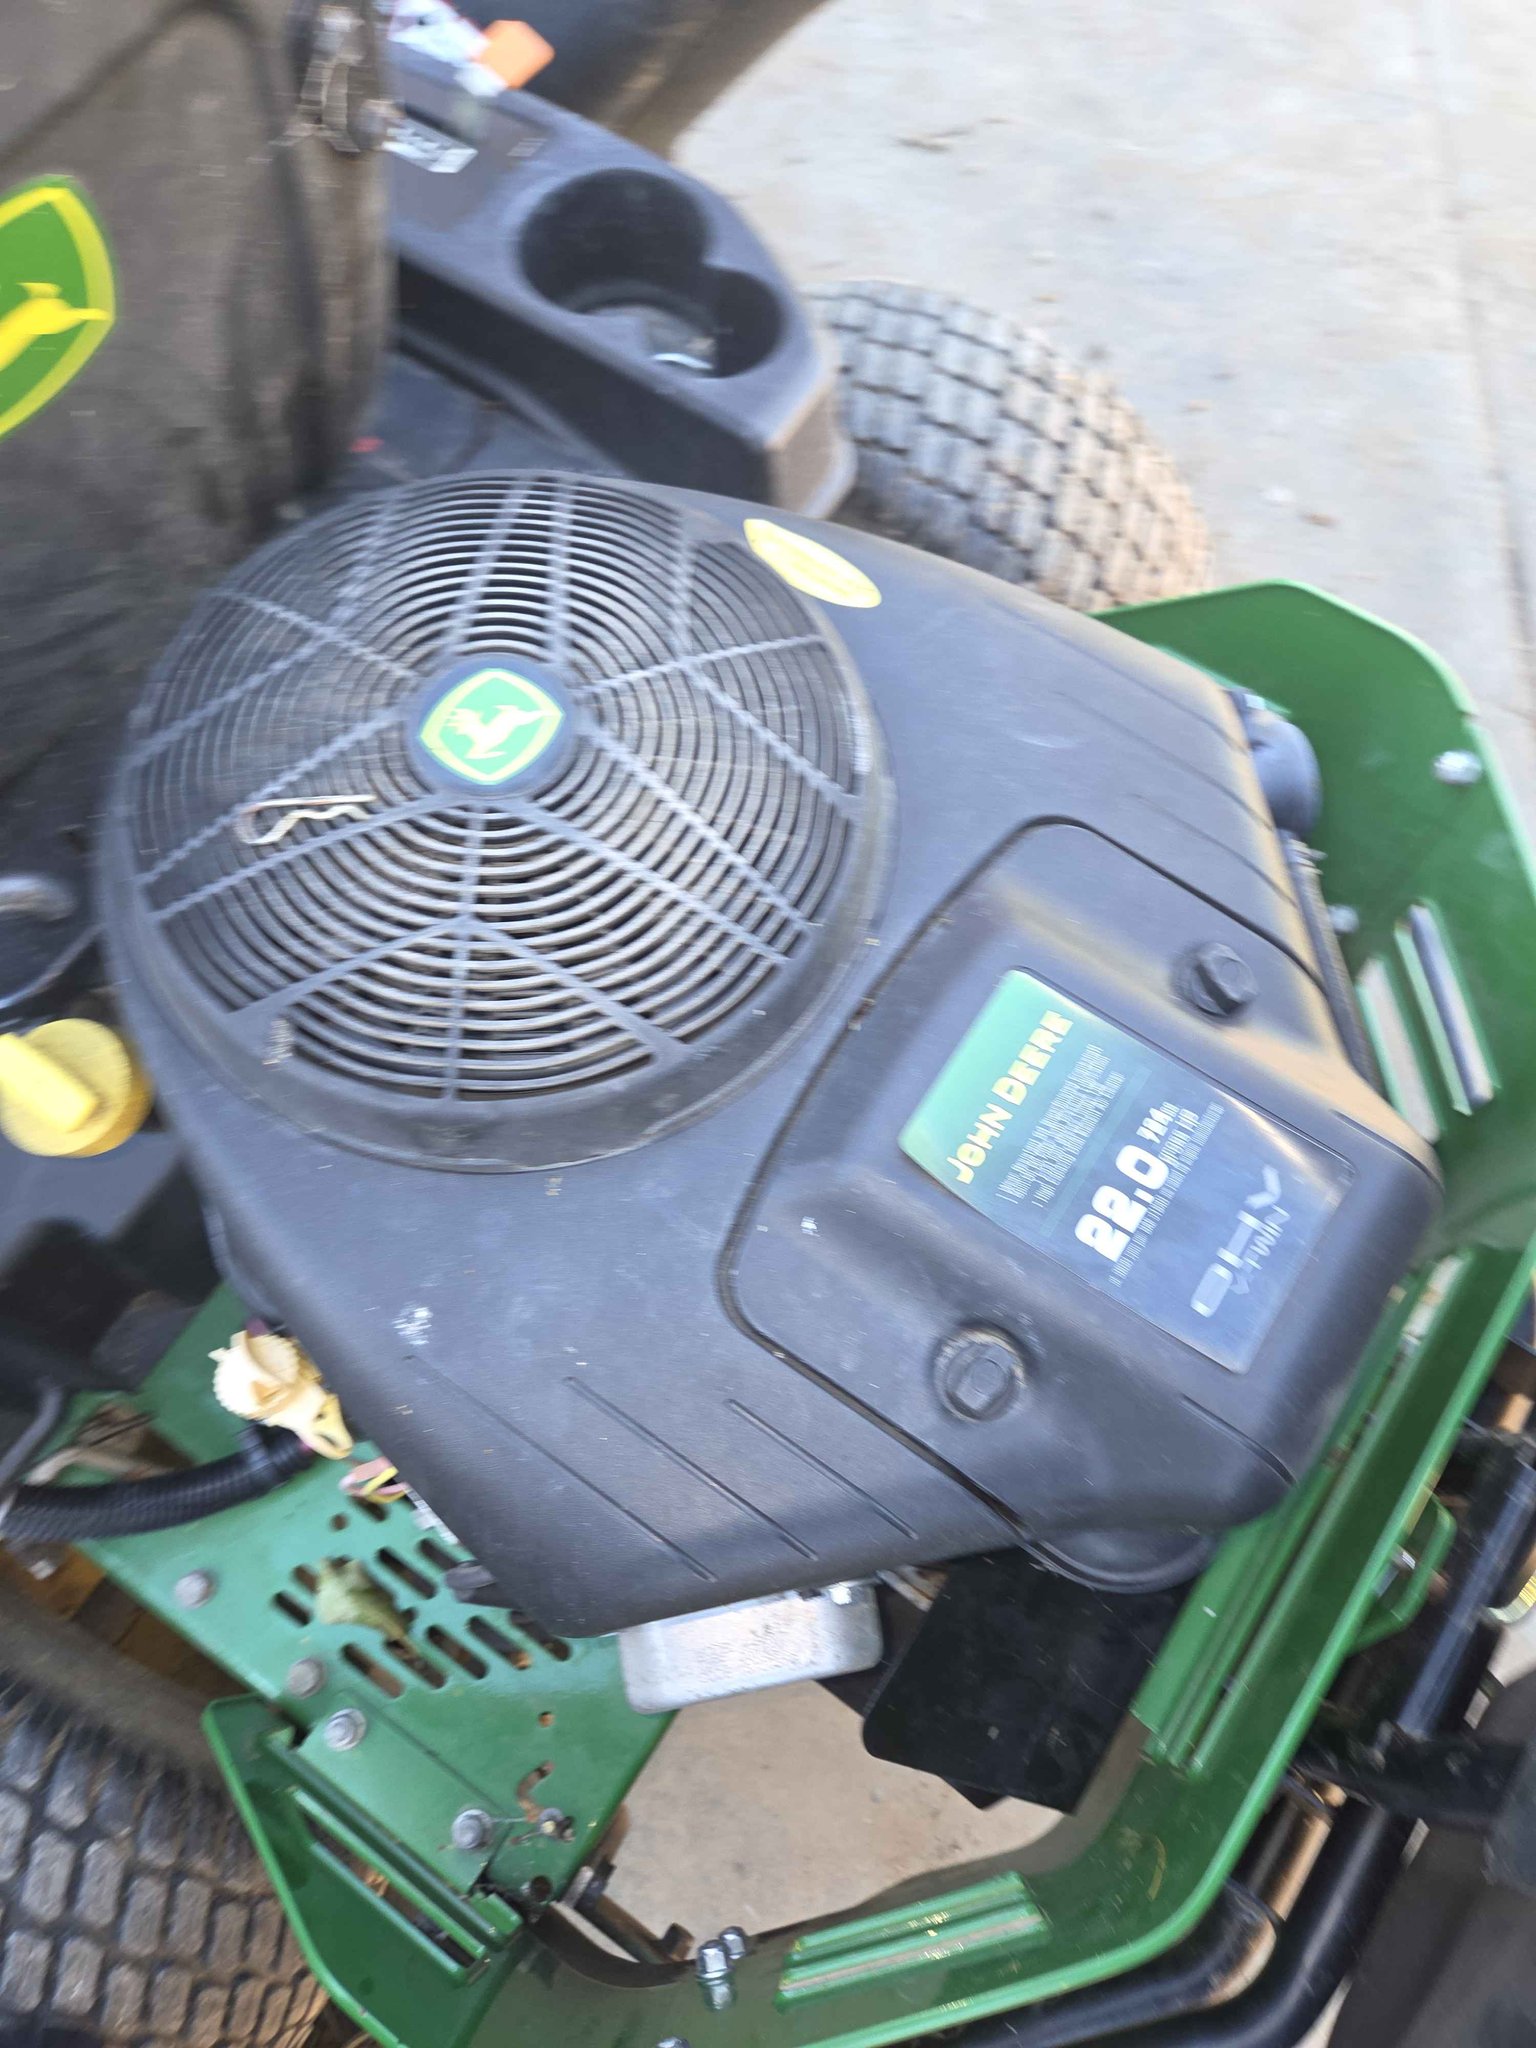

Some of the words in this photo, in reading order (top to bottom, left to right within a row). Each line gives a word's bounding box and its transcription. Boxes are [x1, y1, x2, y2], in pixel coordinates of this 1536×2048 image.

[945, 1102, 1013, 1184] JOHN
[992, 1010, 1073, 1106] DEERE
[1074, 1144, 1169, 1263] 22.0
[1190, 1166, 1283, 1318] OHV
